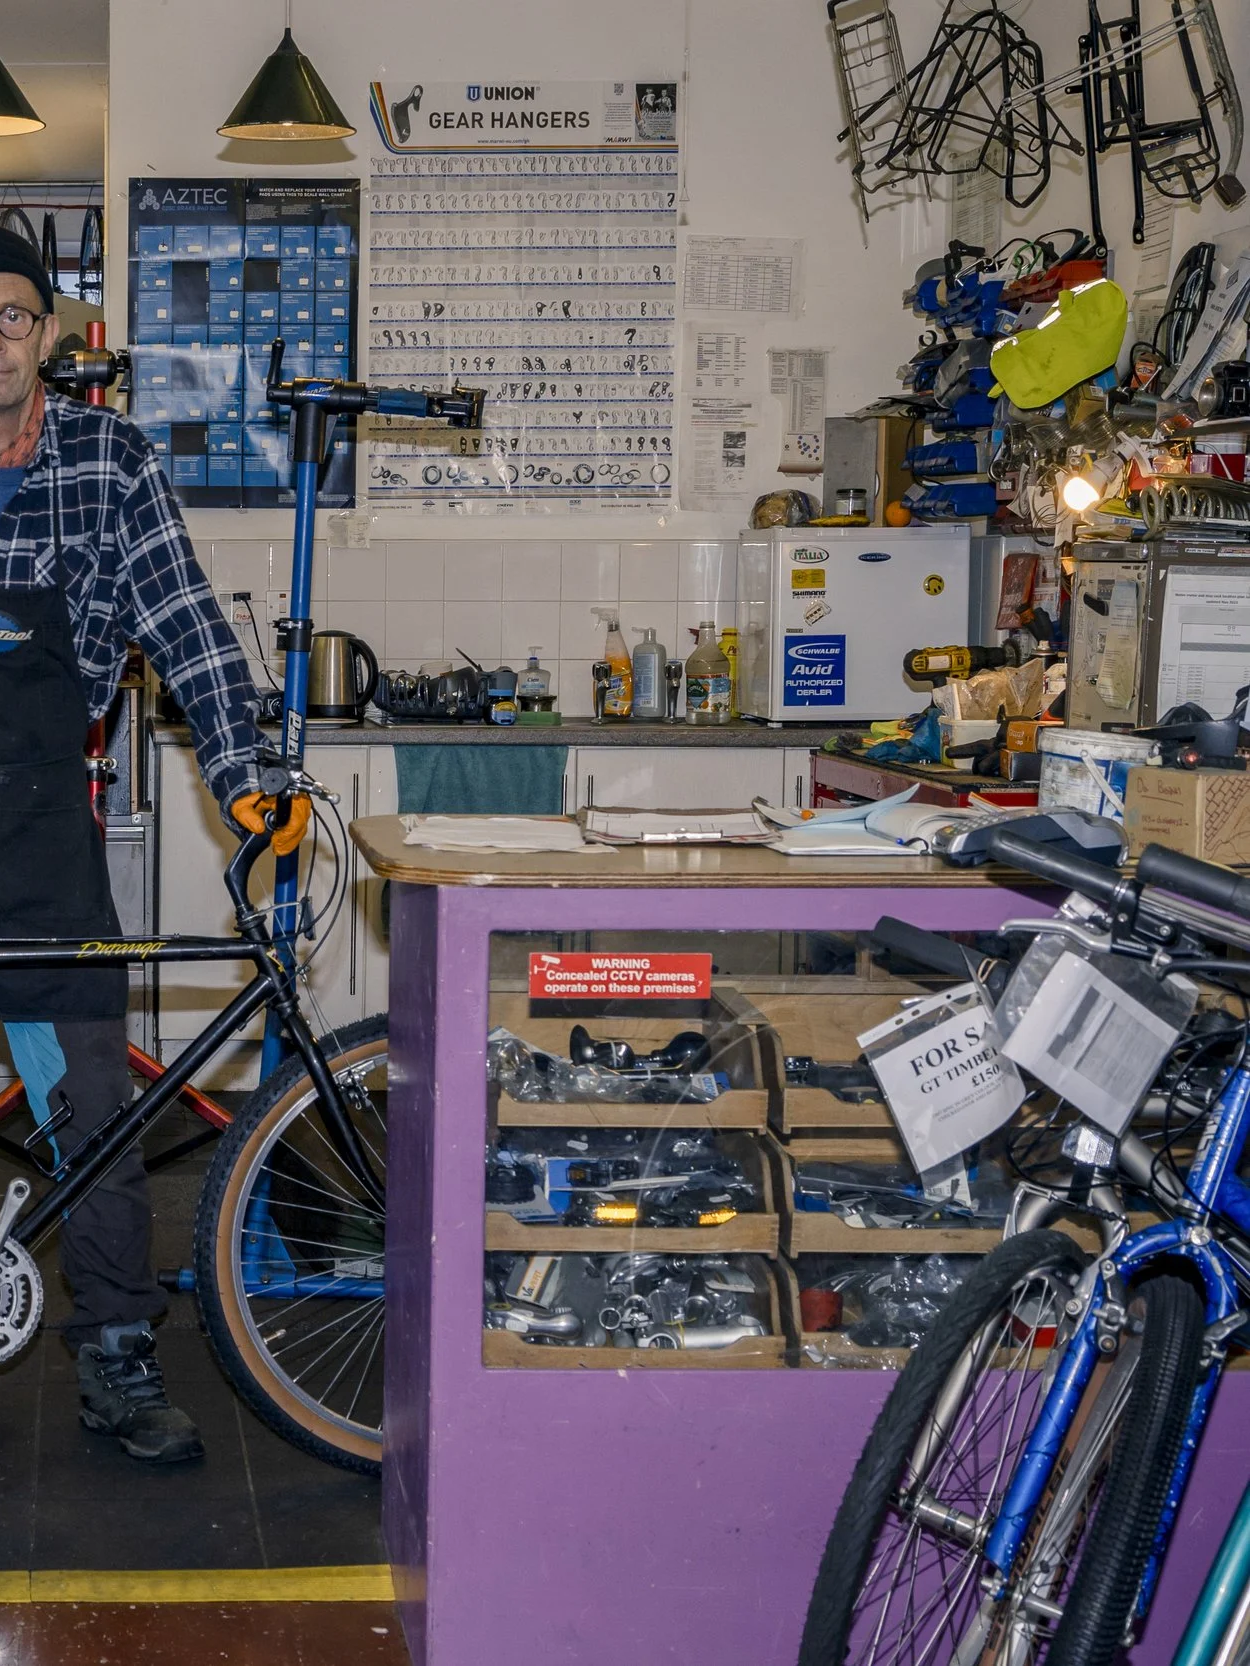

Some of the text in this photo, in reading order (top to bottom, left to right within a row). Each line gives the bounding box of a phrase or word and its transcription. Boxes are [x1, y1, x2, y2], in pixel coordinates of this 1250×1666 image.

[484, 86, 535, 101] UNION
[429, 111, 484, 130] GEAR
[491, 111, 591, 129] HANGERS
[161, 187, 228, 205] AZTEC
[793, 551, 824, 560] ITALIA
[796, 647, 841, 655] SCHWALBE
[791, 664, 835, 675] Avid
[785, 679, 843, 687] AUTHORIZED
[288, 709, 303, 757] Par
[76, 941, 167, 960] Durango
[591, 958, 651, 970] WARNING
[546, 970, 695, 981] Concealed CCTV cameras
[544, 982, 696, 995] operate on these premises
[909, 1037, 963, 1078] FOR
[971, 1063, 1000, 1088] £150
[920, 1076, 941, 1095] GT
